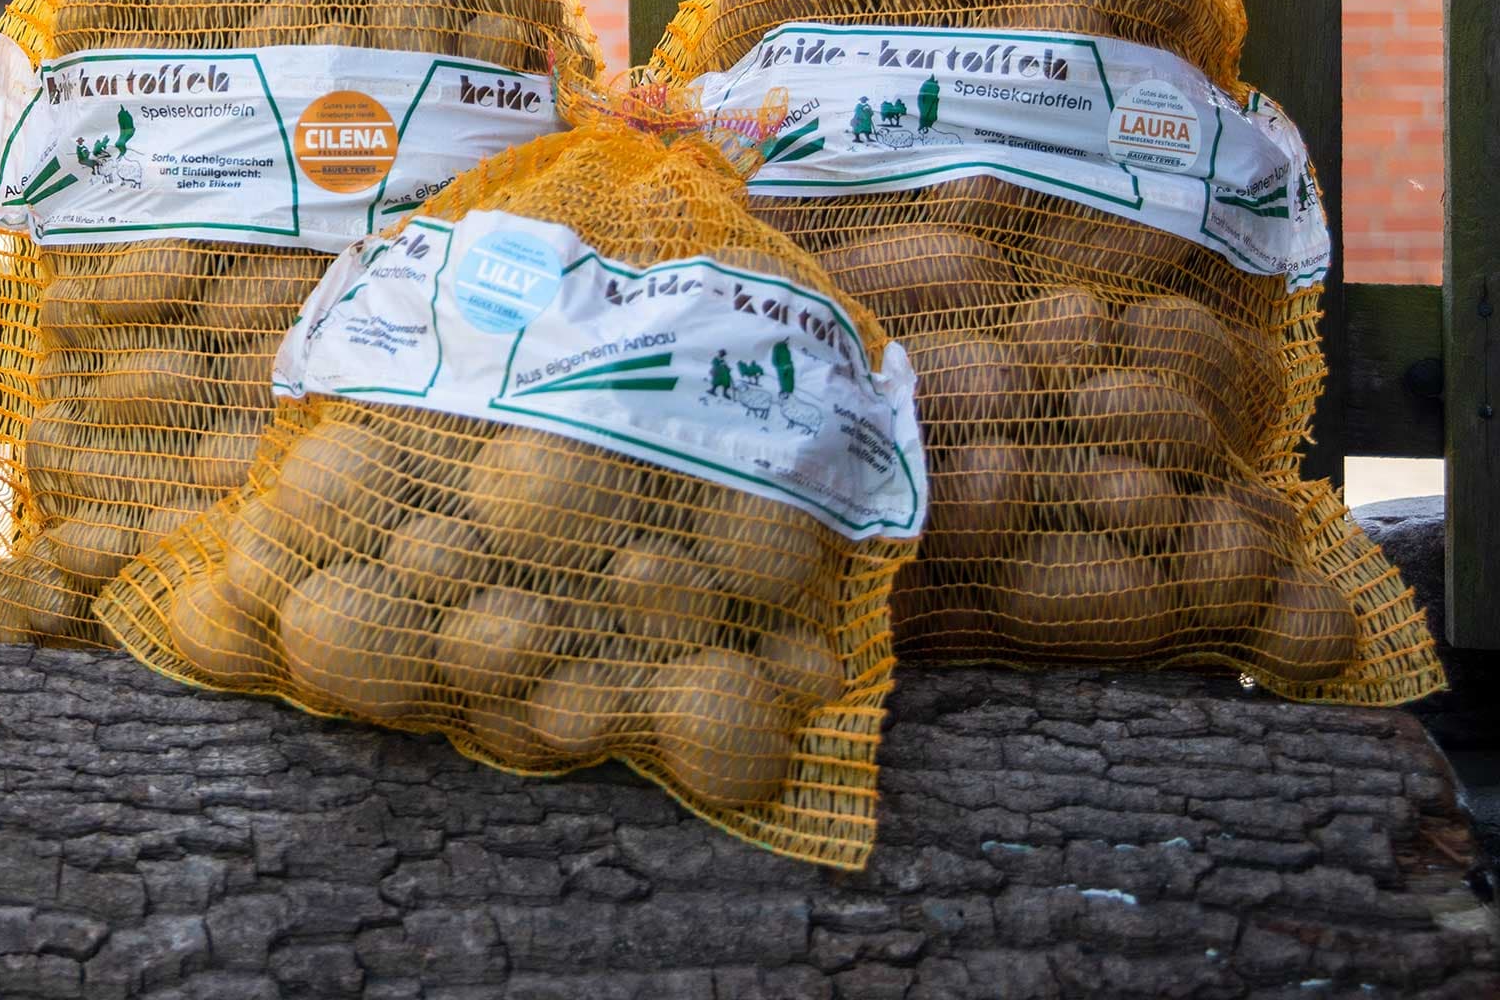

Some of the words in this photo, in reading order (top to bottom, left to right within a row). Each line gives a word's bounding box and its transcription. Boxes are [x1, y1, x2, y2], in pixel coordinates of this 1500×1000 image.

[877, 39, 1069, 81] kartoffeln
[459, 74, 541, 113] heide
[954, 79, 1093, 112] Speisekartoffeln
[1132, 97, 1167, 109] Lüneburger
[1167, 102, 1184, 111] Heide
[1139, 88, 1157, 98] Gutes
[1158, 92, 1169, 100] aus
[140, 102, 255, 121] Speisekartoffeln
[779, 97, 821, 134] Anbau
[304, 128, 388, 149] CILENA
[1119, 114, 1190, 142] LAURA
[151, 153, 178, 165] Sorte,
[181, 153, 274, 168] Kocheigenschaft
[159, 166, 180, 176] und
[182, 166, 262, 180] Einfüllgewicht:
[176, 179, 206, 189] siehe
[209, 180, 242, 189] Etikett
[476, 259, 542, 294] LILLY
[515, 366, 543, 388] Aus
[545, 342, 620, 374] eigenem
[622, 330, 678, 353] Anbau
